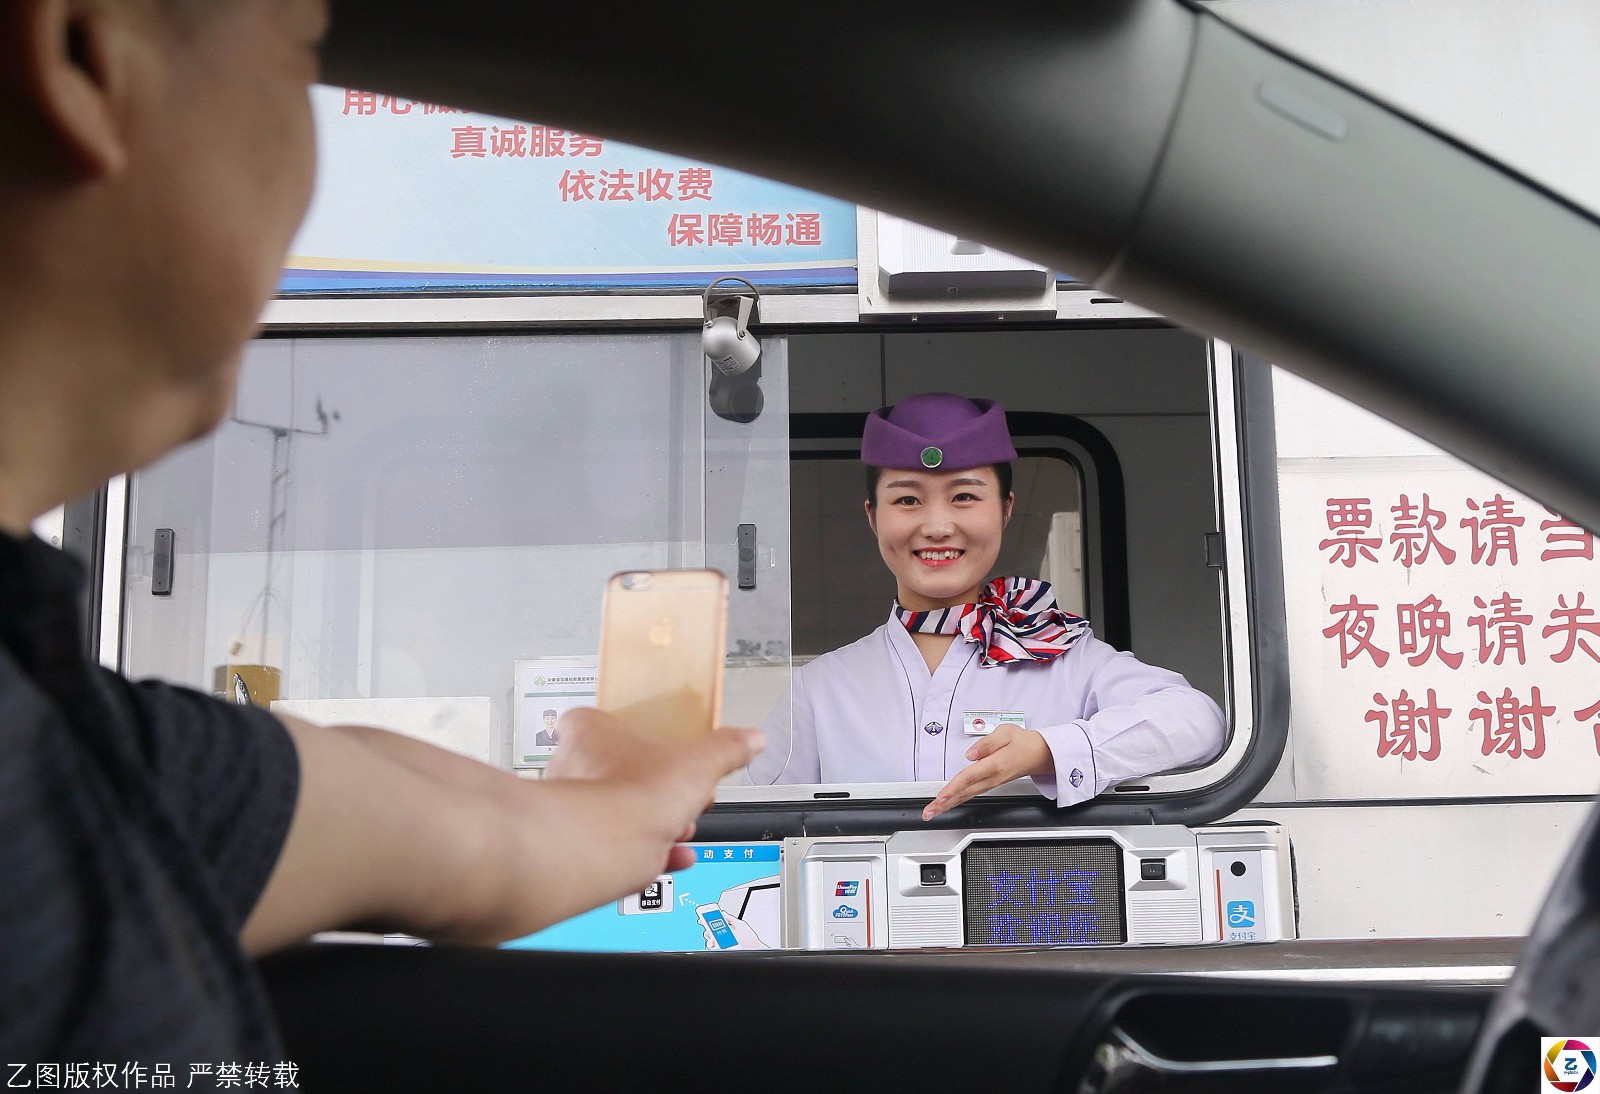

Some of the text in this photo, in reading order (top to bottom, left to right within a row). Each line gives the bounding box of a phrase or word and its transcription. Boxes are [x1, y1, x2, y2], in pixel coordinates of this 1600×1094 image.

[450, 125, 604, 158] 真诚服务
[559, 168, 713, 202] 依法收费
[667, 213, 823, 247] 保障畅通
[1318, 493, 1594, 568] 票款请当
[1322, 591, 1600, 670] 夜晚请关
[986, 868, 1099, 907] 支付宝
[986, 911, 1100, 944] 欢迎您
[1230, 931, 1256, 941] 支付宝
